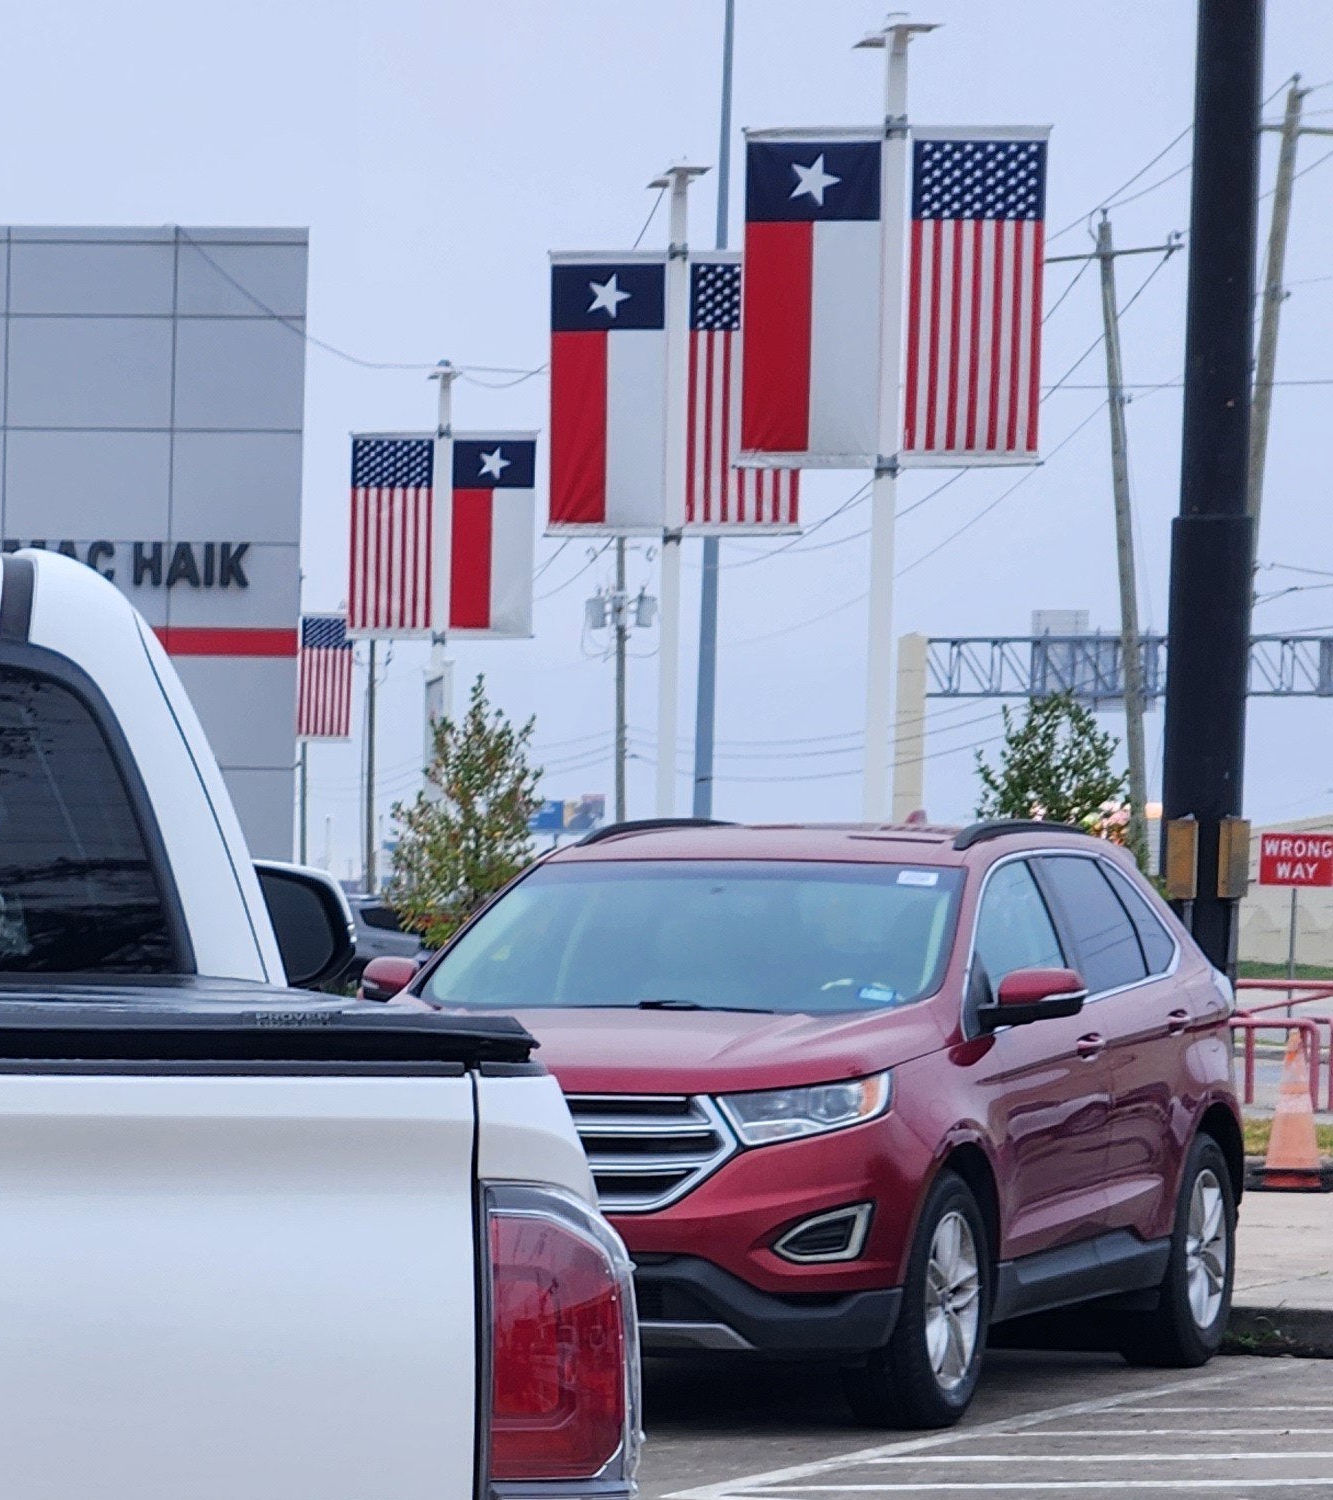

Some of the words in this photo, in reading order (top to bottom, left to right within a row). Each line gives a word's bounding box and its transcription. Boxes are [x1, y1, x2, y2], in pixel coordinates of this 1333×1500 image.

[132, 541, 251, 588] HAIK
[1264, 838, 1333, 858] WRONG
[1275, 861, 1319, 879] WAY
